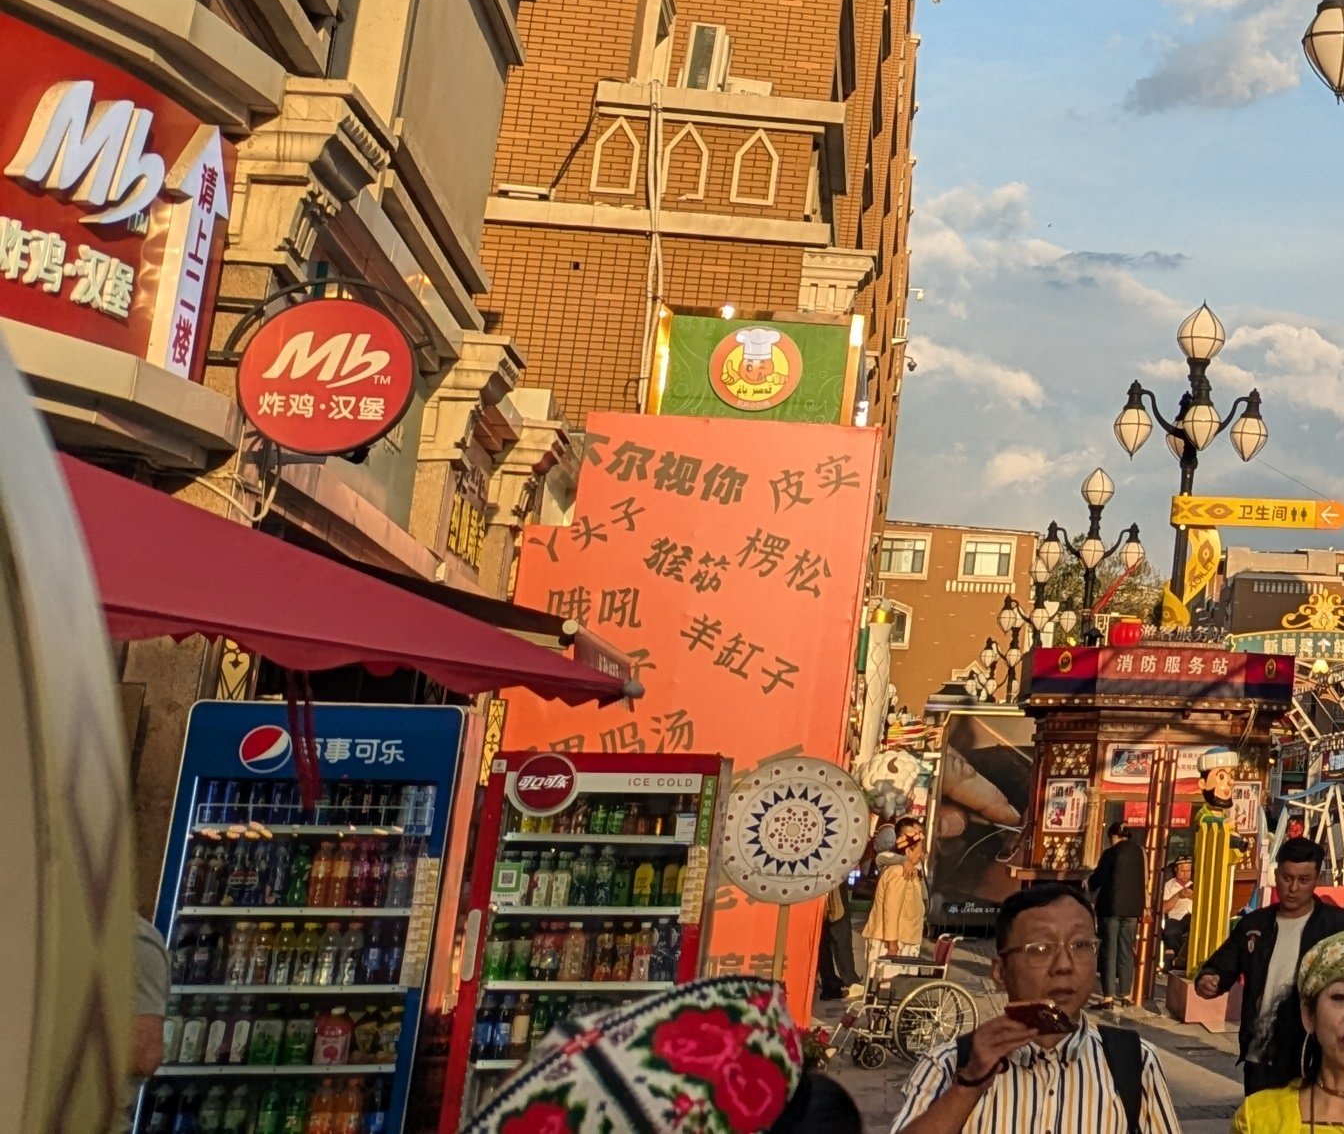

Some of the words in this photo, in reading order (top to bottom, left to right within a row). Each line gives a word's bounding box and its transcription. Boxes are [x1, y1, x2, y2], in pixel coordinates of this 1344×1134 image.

[172, 163, 219, 367] 请上二楼
[372, 374, 392, 386] TM
[768, 453, 861, 515] 皮实
[1237, 504, 1289, 523] 卫生间
[735, 527, 833, 599] 楞松
[679, 612, 801, 696] 羊缸子
[1116, 653, 1230, 676] 消防服务站
[517, 773, 572, 791] 可口可乐
[627, 777, 651, 788] ICE
[656, 777, 694, 788] COLD
